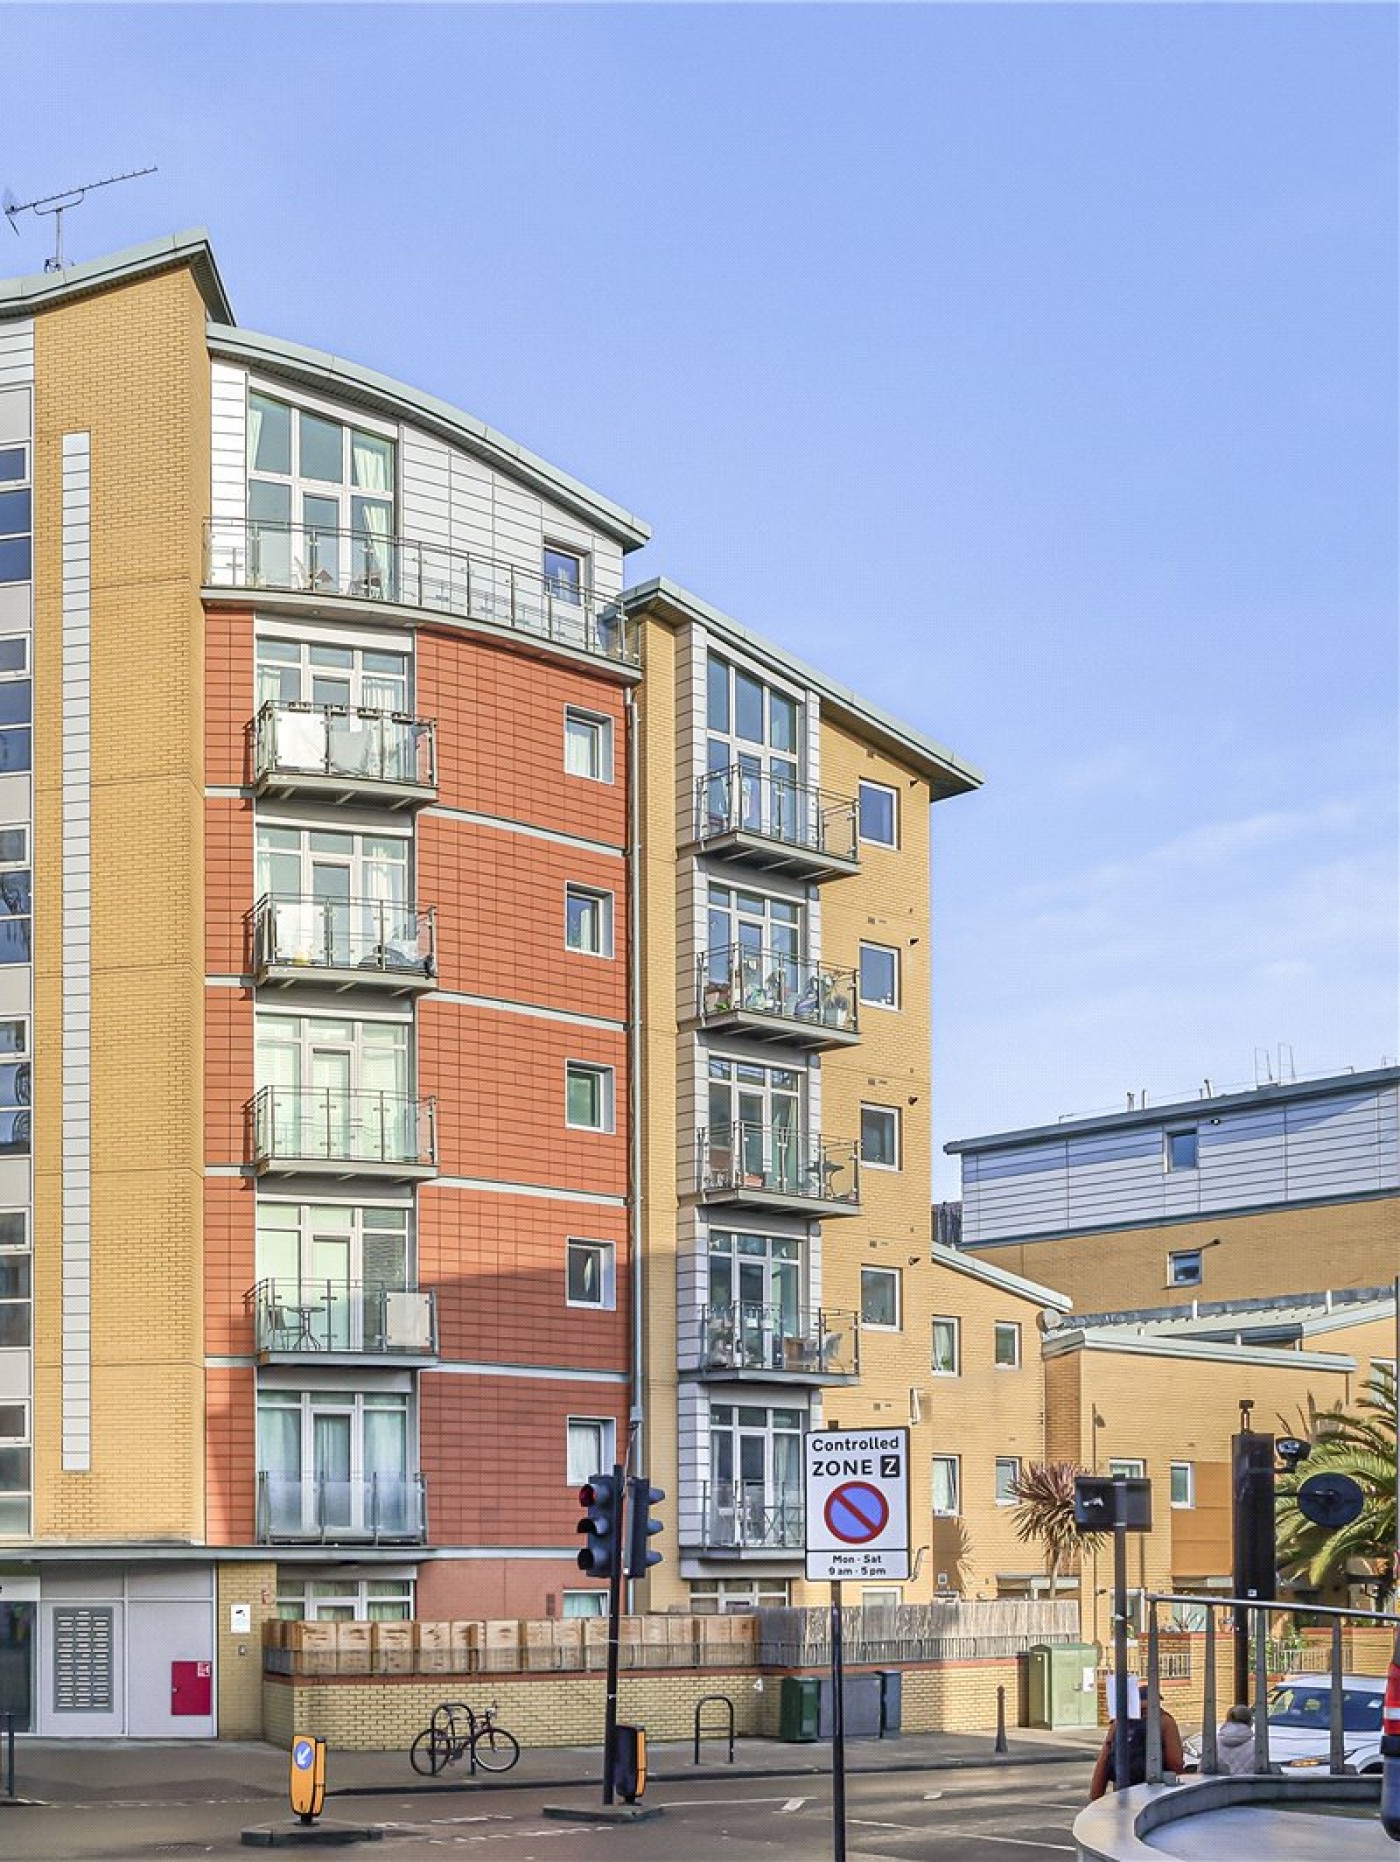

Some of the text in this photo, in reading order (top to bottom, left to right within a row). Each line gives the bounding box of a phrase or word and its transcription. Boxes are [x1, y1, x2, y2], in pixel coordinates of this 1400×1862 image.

[811, 1437, 899, 1452] Controlled
[811, 1457, 898, 1476] ZONE Z
[832, 1555, 855, 1564] Mon
[863, 1554, 882, 1564] Sat
